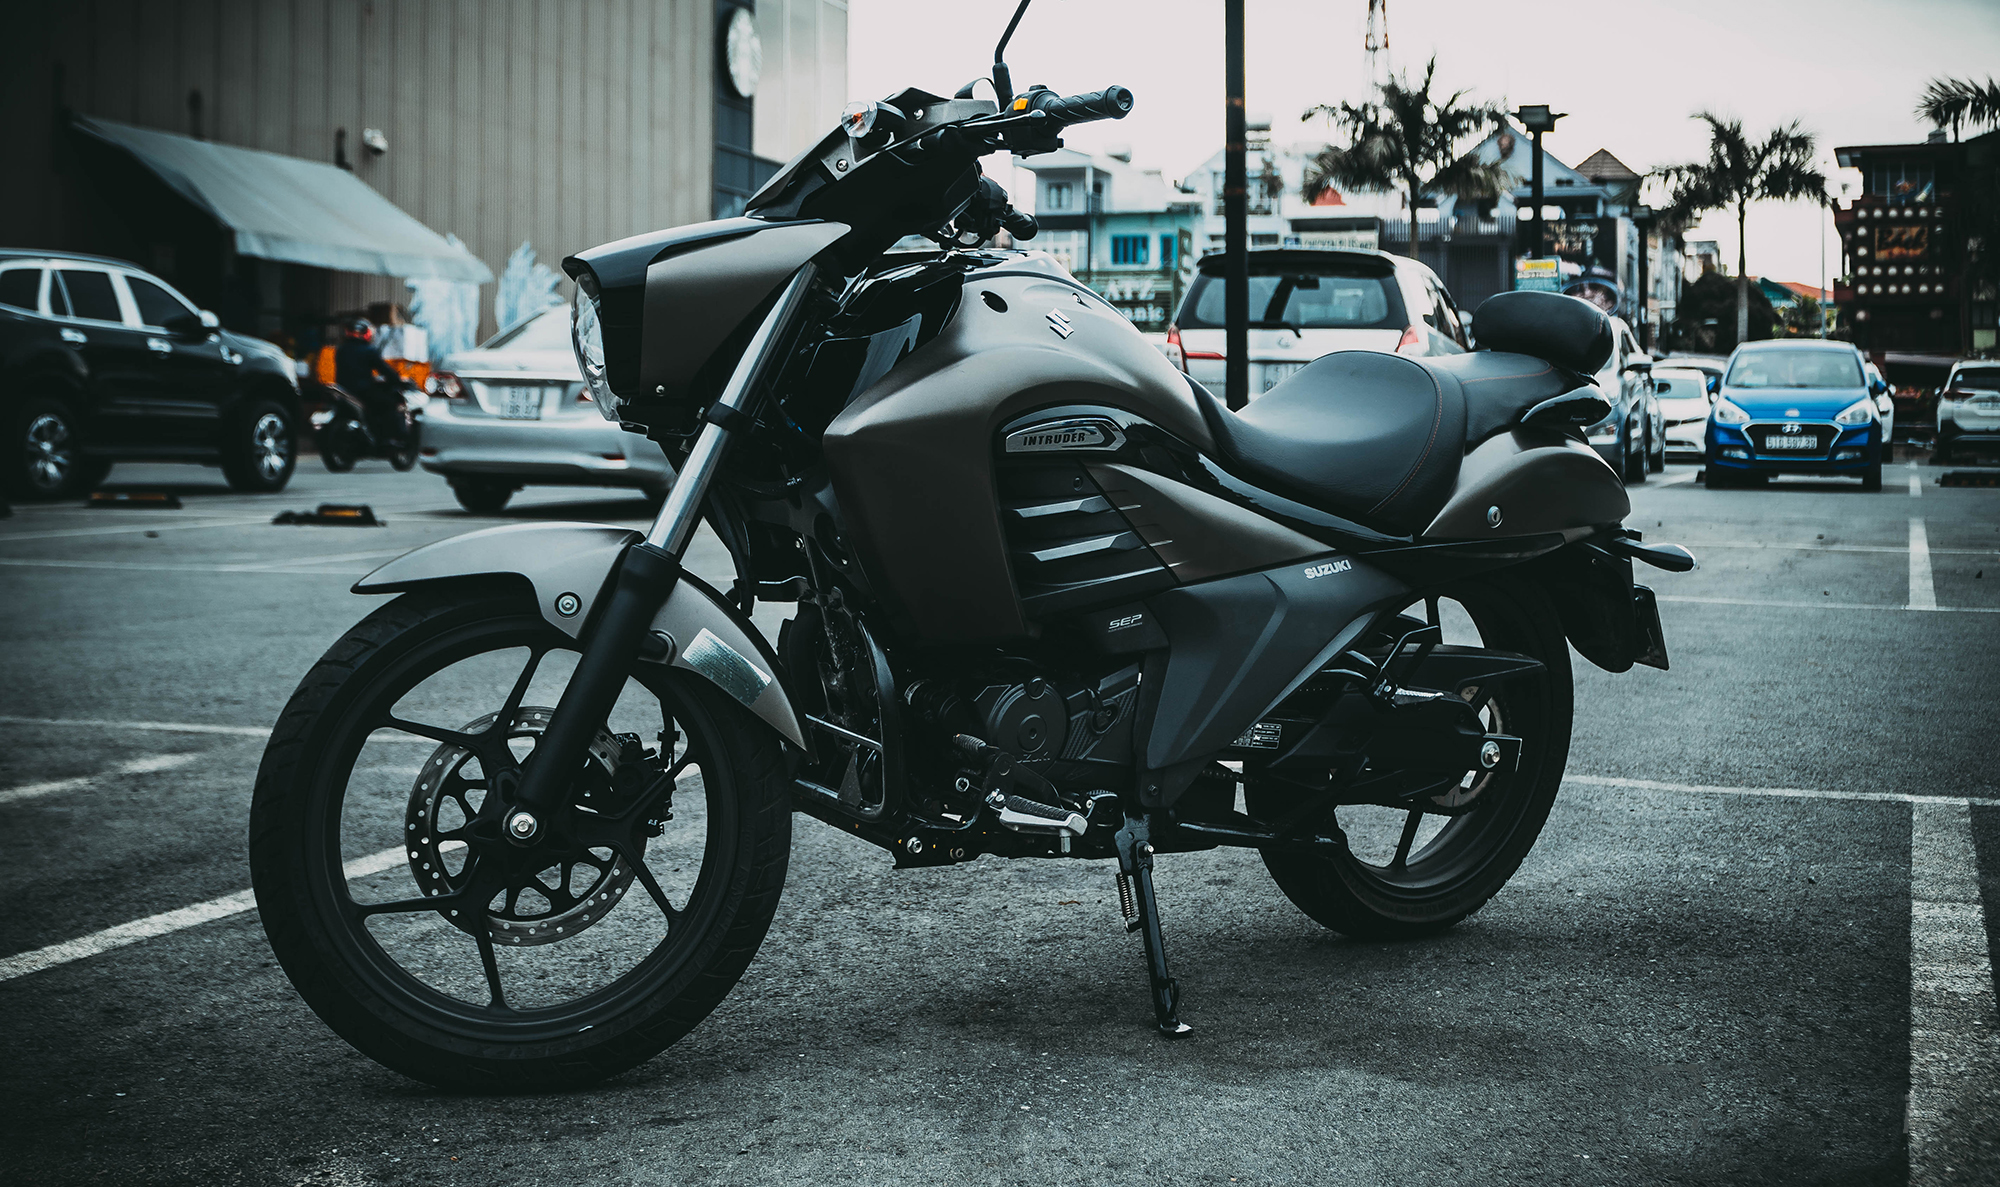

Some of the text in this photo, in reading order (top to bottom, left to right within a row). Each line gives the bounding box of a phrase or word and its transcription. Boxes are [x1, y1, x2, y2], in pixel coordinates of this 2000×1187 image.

[1023, 432, 1085, 446] INTRUDER
[1304, 559, 1351, 579] SUZUKI
[1108, 613, 1143, 630] SEP
